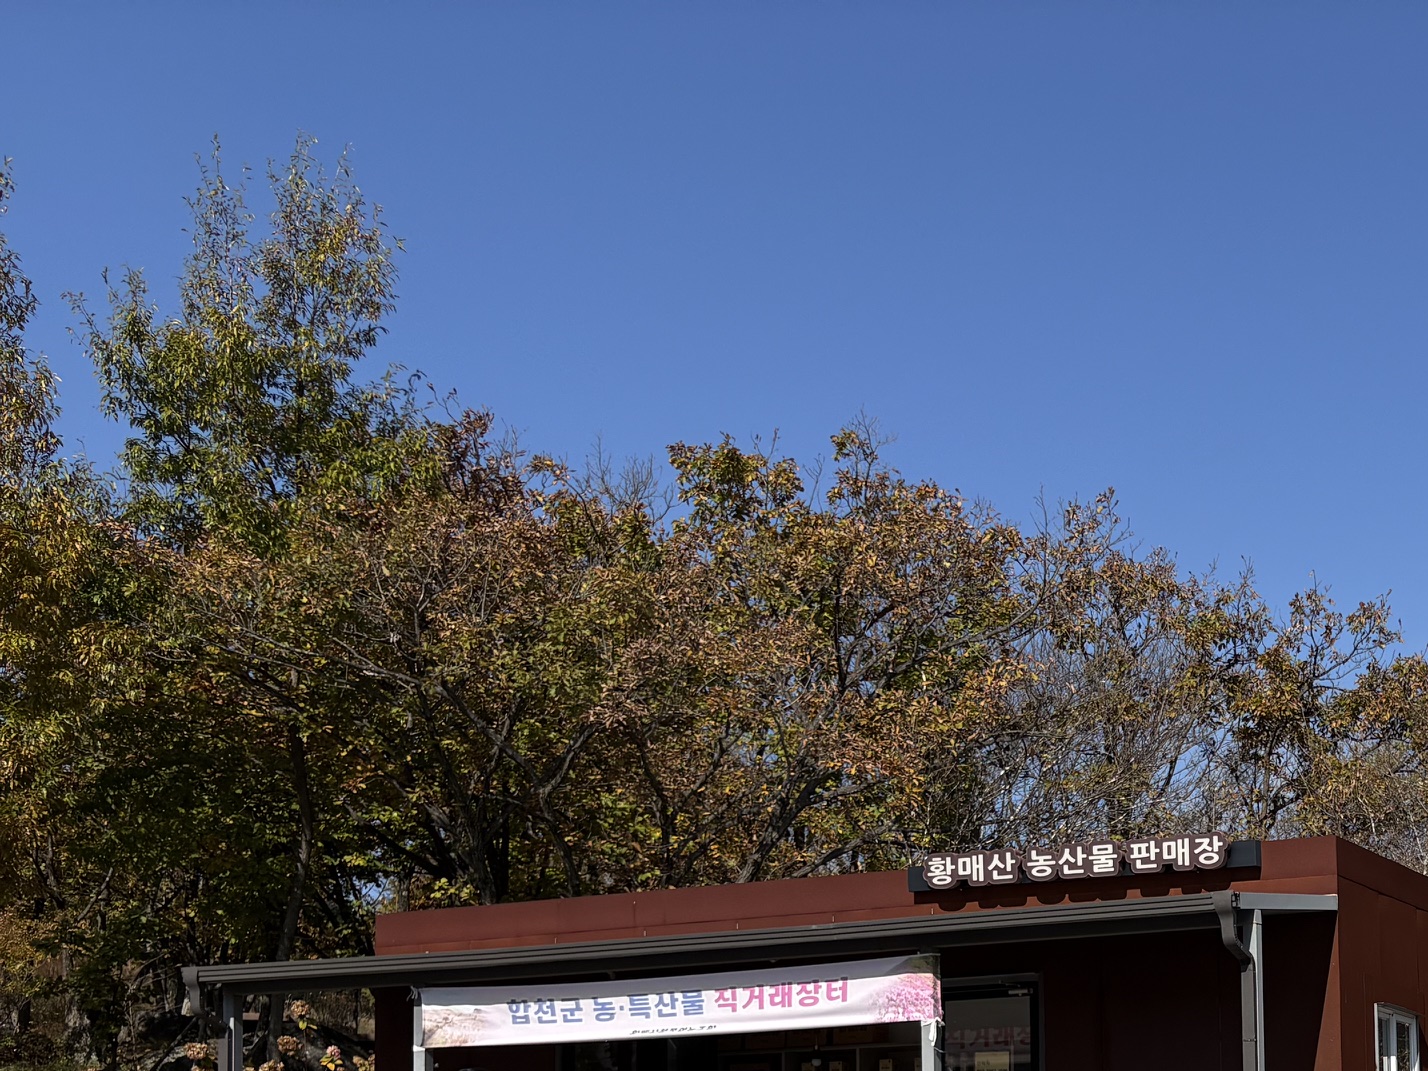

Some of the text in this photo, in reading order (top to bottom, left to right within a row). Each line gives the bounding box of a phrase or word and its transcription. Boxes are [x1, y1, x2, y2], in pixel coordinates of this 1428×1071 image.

[927, 835, 1224, 886] 황매산 농산물 판매장
[508, 977, 850, 1025] 합천군 농·특산물 직거래장터
